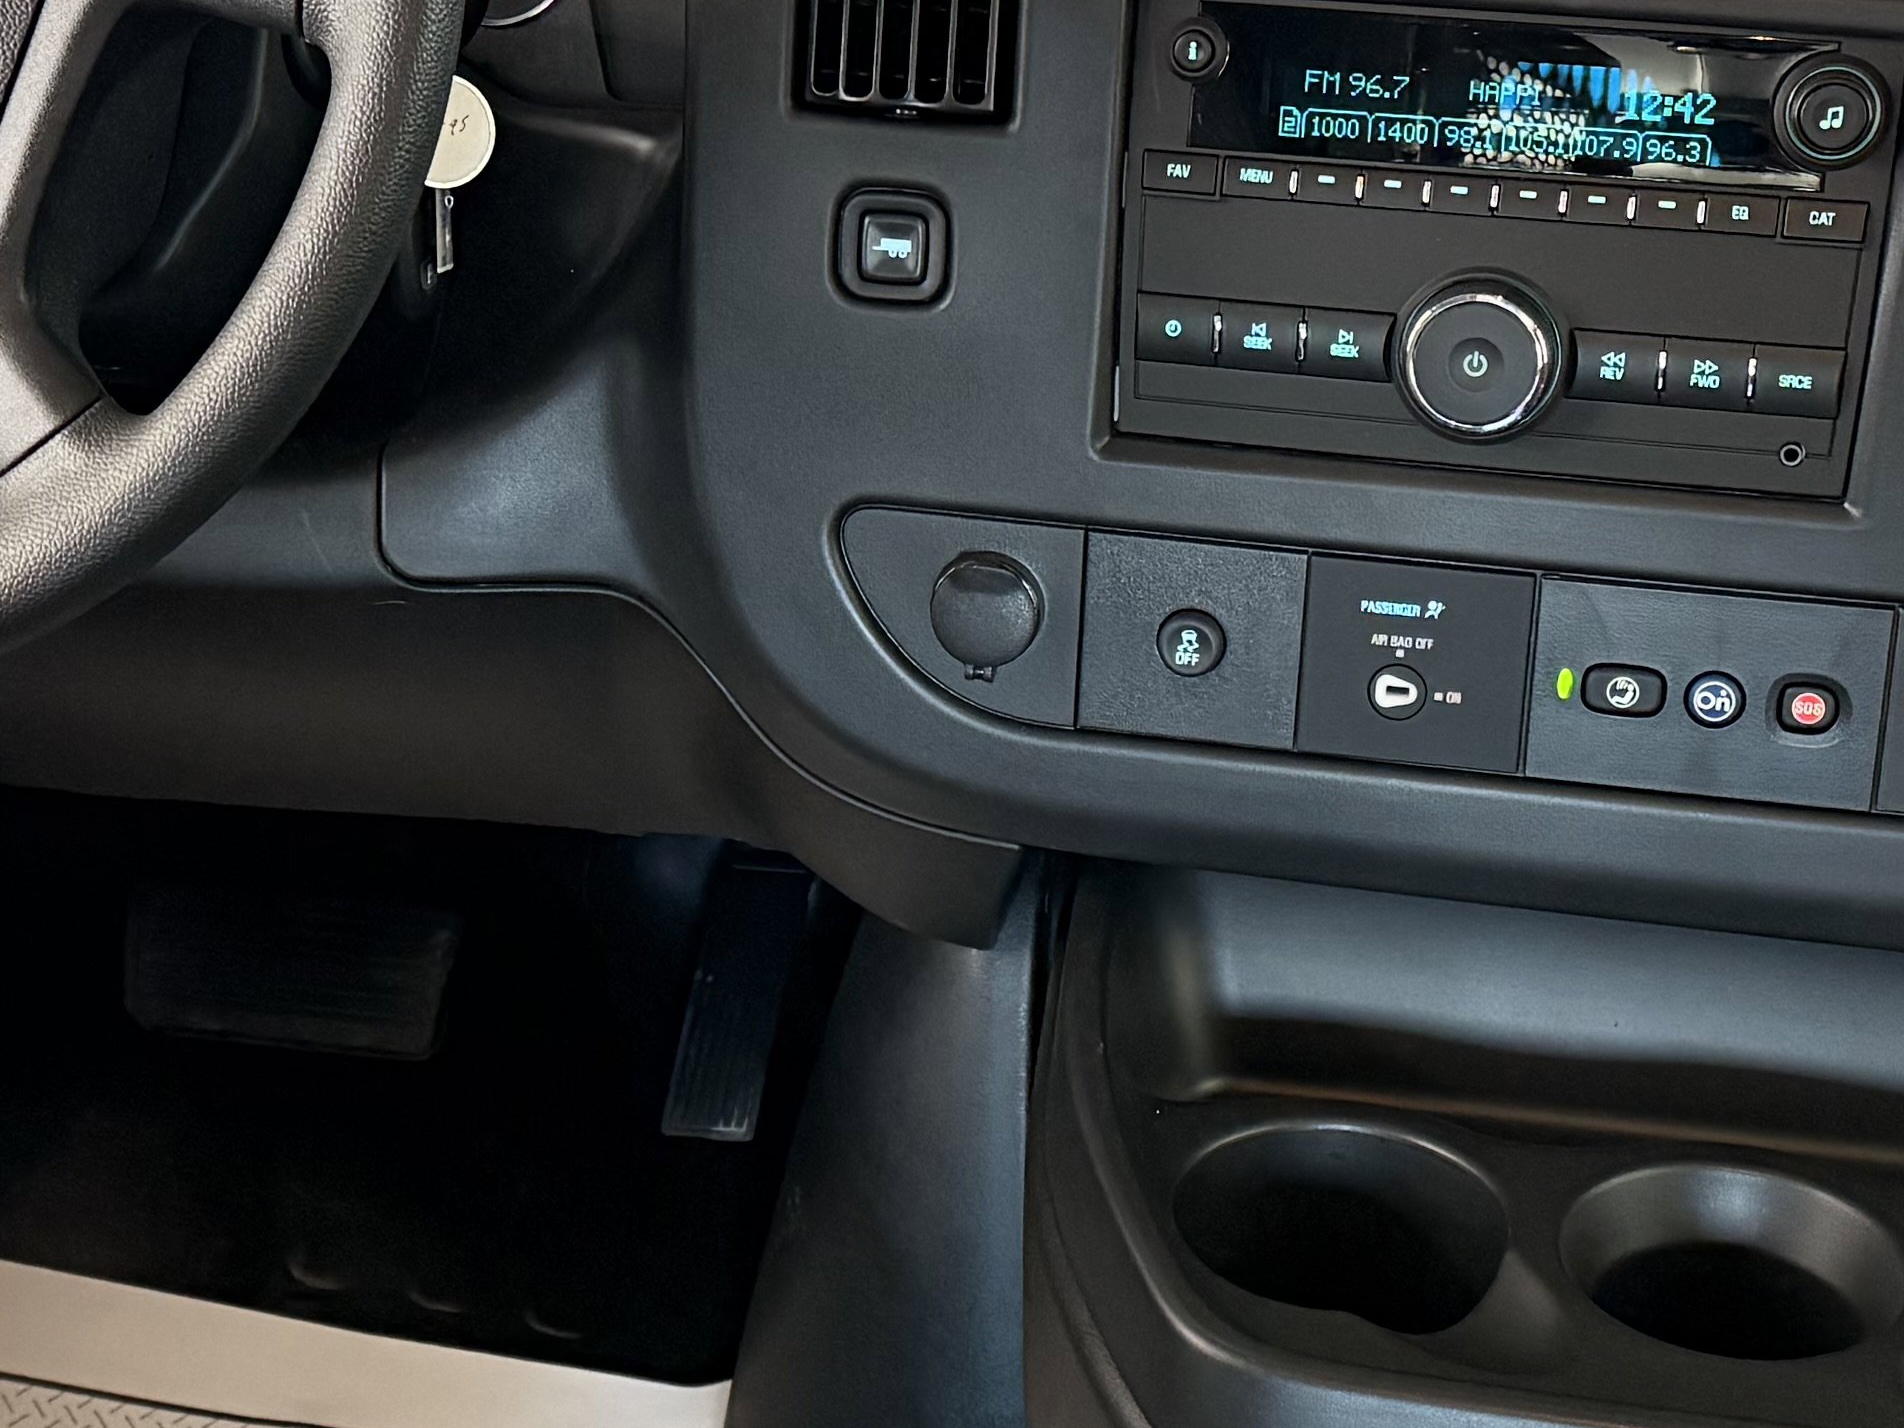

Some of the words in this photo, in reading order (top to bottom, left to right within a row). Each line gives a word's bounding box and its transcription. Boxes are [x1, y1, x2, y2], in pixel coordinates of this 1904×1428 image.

[1304, 70, 1341, 95] FM
[1348, 74, 1410, 100] 96.7
[1623, 92, 1717, 125] 12:42
[1310, 117, 1360, 139] 1000
[1377, 122, 1428, 145] 1400
[1444, 127, 1494, 150] 98.1
[1646, 137, 1701, 162] 96.3
[1167, 164, 1191, 178] FAV
[1240, 168, 1273, 184] MENU
[1809, 211, 1836, 226] CAT
[1243, 336, 1272, 350] SEEK
[1330, 343, 1360, 358] SEEK
[1600, 366, 1624, 381] REV
[1690, 374, 1720, 388] FWD
[1778, 374, 1812, 390] SRCE
[1371, 634, 1388, 646] AIR
[1390, 634, 1412, 648] BAG
[1416, 637, 1434, 650] OFF
[1176, 652, 1200, 666] OFF
[1446, 692, 1462, 704] ON
[1795, 702, 1822, 716] SOS
